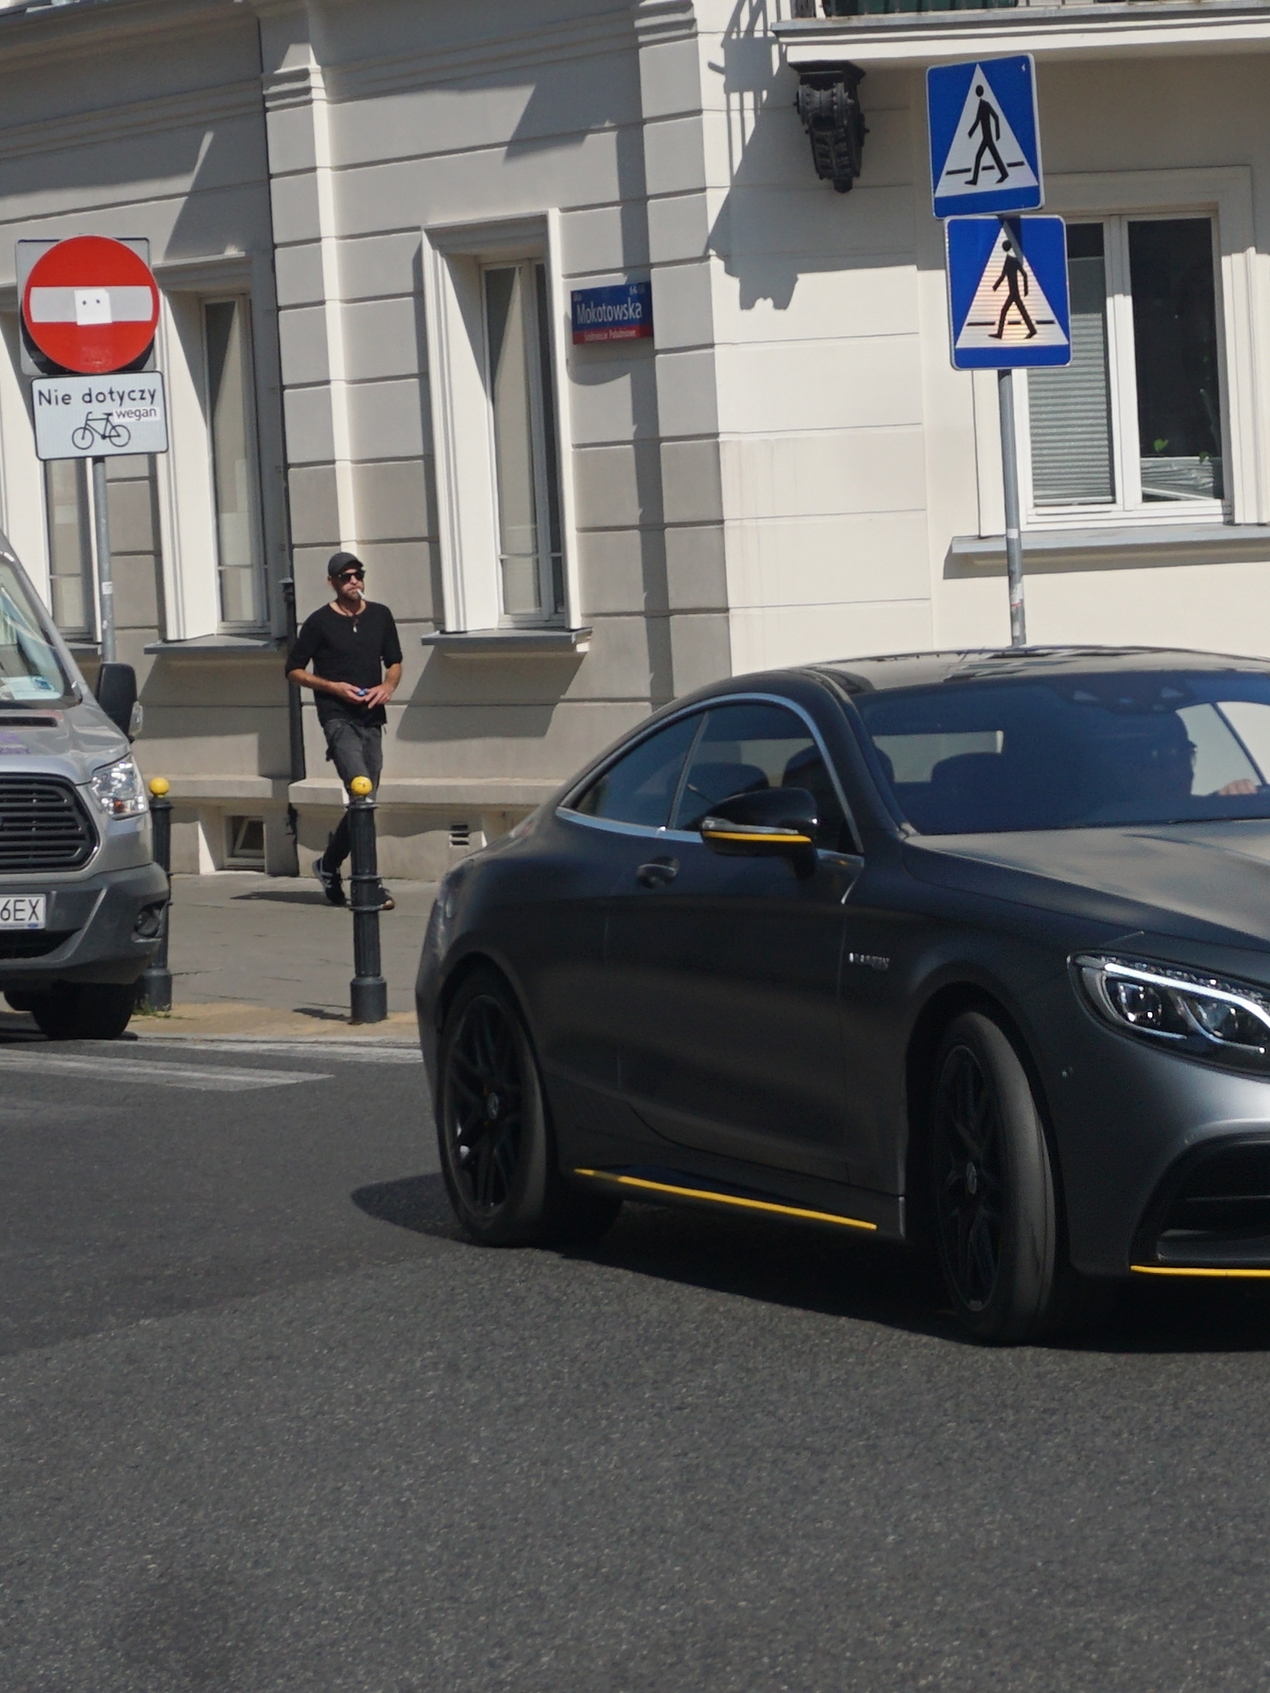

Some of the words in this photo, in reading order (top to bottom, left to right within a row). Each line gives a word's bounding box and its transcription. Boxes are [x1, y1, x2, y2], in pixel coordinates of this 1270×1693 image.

[576, 296, 643, 325] Mokotowska
[38, 388, 73, 406] Nie
[81, 385, 157, 407] dotyczy
[115, 407, 157, 421] wegan
